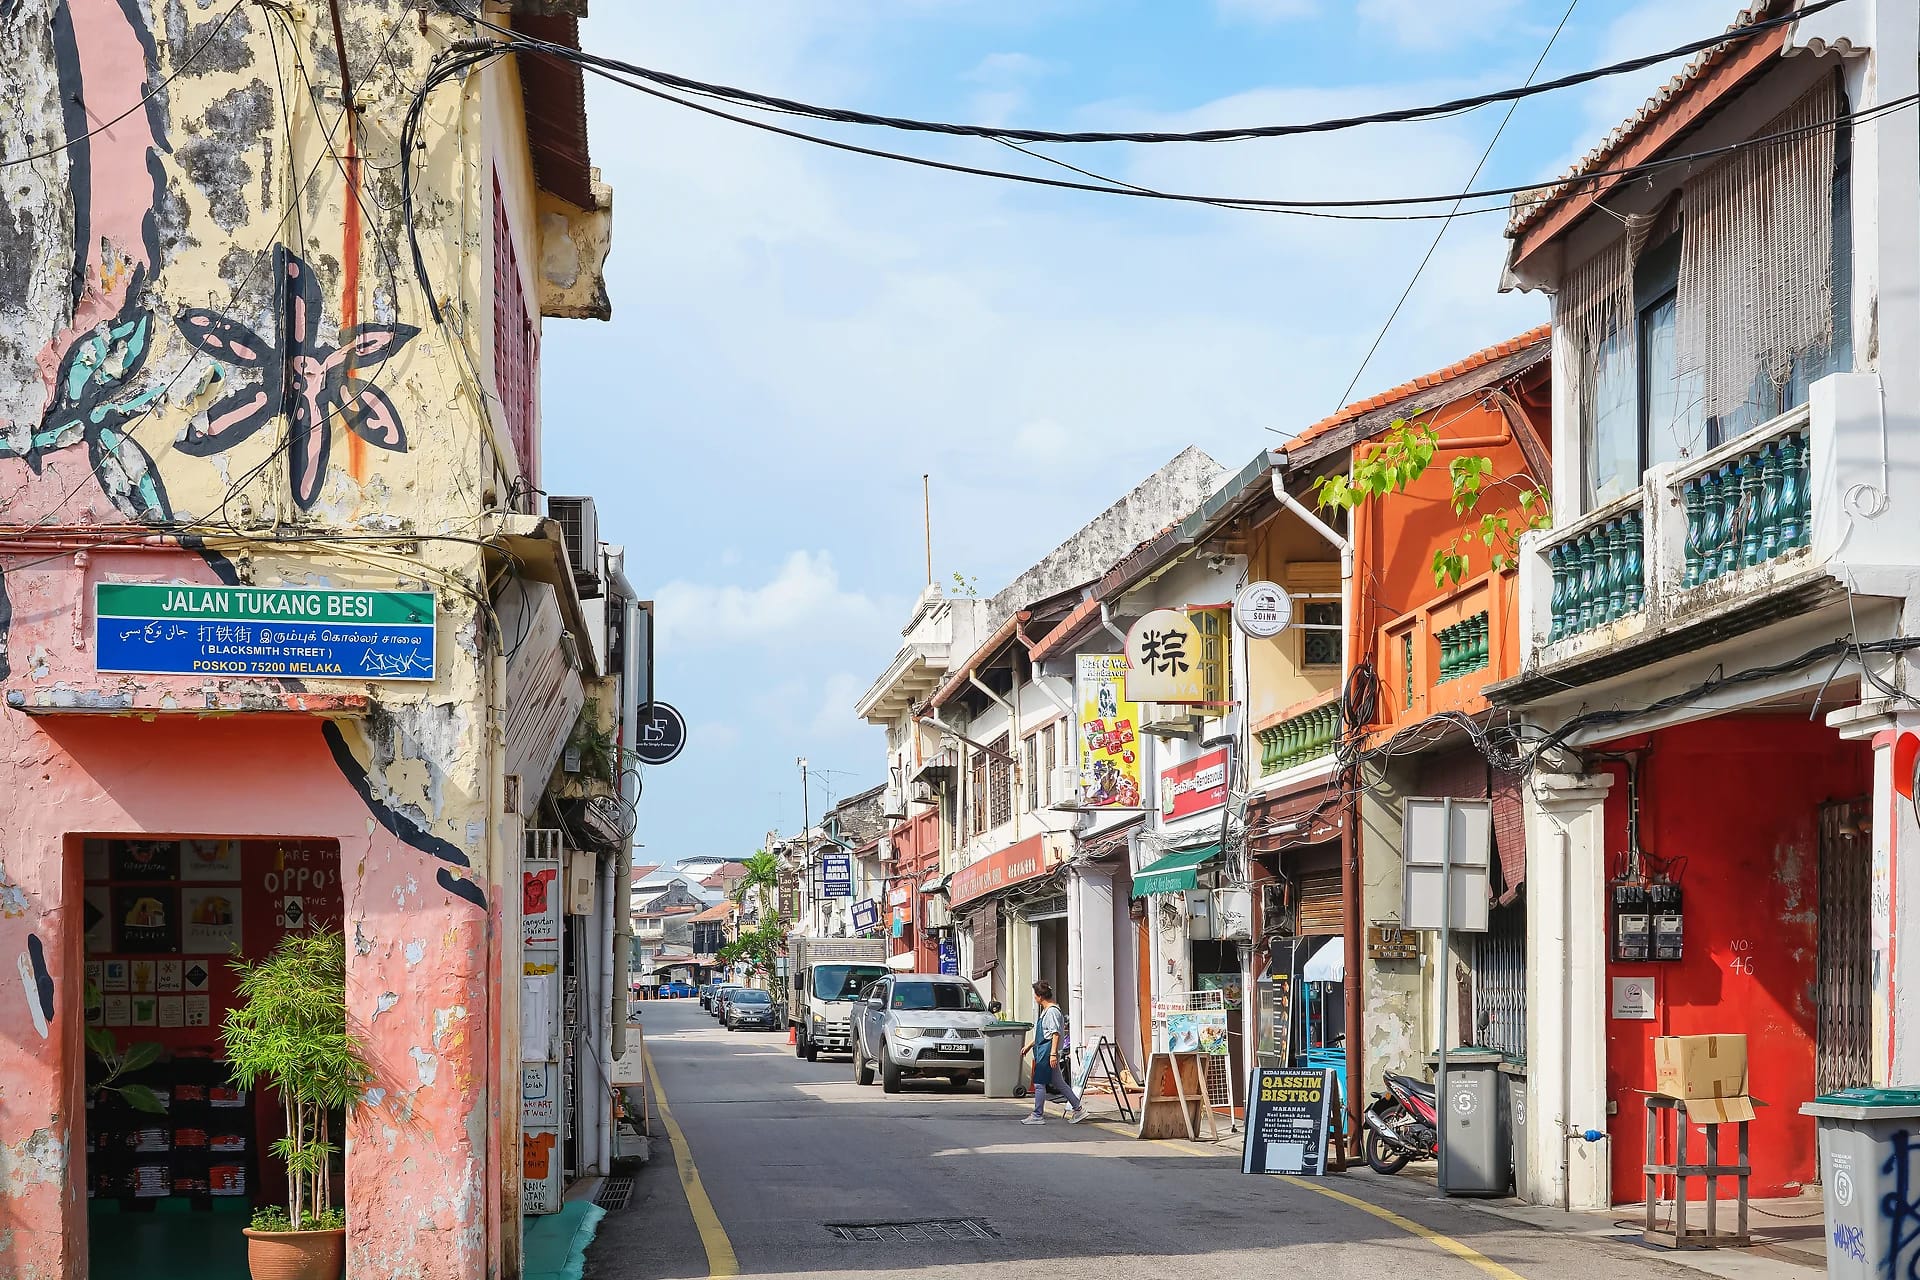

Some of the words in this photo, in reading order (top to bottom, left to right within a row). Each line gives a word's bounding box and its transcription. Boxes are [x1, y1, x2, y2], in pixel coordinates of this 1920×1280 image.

[162, 591, 228, 613] JALAN
[235, 592, 321, 616] TUKANG
[328, 595, 373, 617] BESI
[197, 624, 251, 643] 打铁街
[259, 628, 317, 644] இரும்புக்
[321, 629, 378, 645] கொல்லர்
[381, 635, 422, 645] சாலை
[209, 645, 279, 655] BLACKSMITH
[283, 648, 325, 657] STREET
[1141, 629, 1189, 677] 粽
[193, 660, 246, 671] POSKOD
[251, 661, 285, 672] 75200
[289, 662, 341, 673] MELAKA
[264, 867, 335, 893] OPPOS
[523, 918, 554, 930] rangutan
[1729, 939, 1753, 951] NO:
[1729, 956, 1754, 975] 46
[1262, 1077, 1322, 1088] QASSIM
[1261, 1090, 1320, 1102] BISTRO
